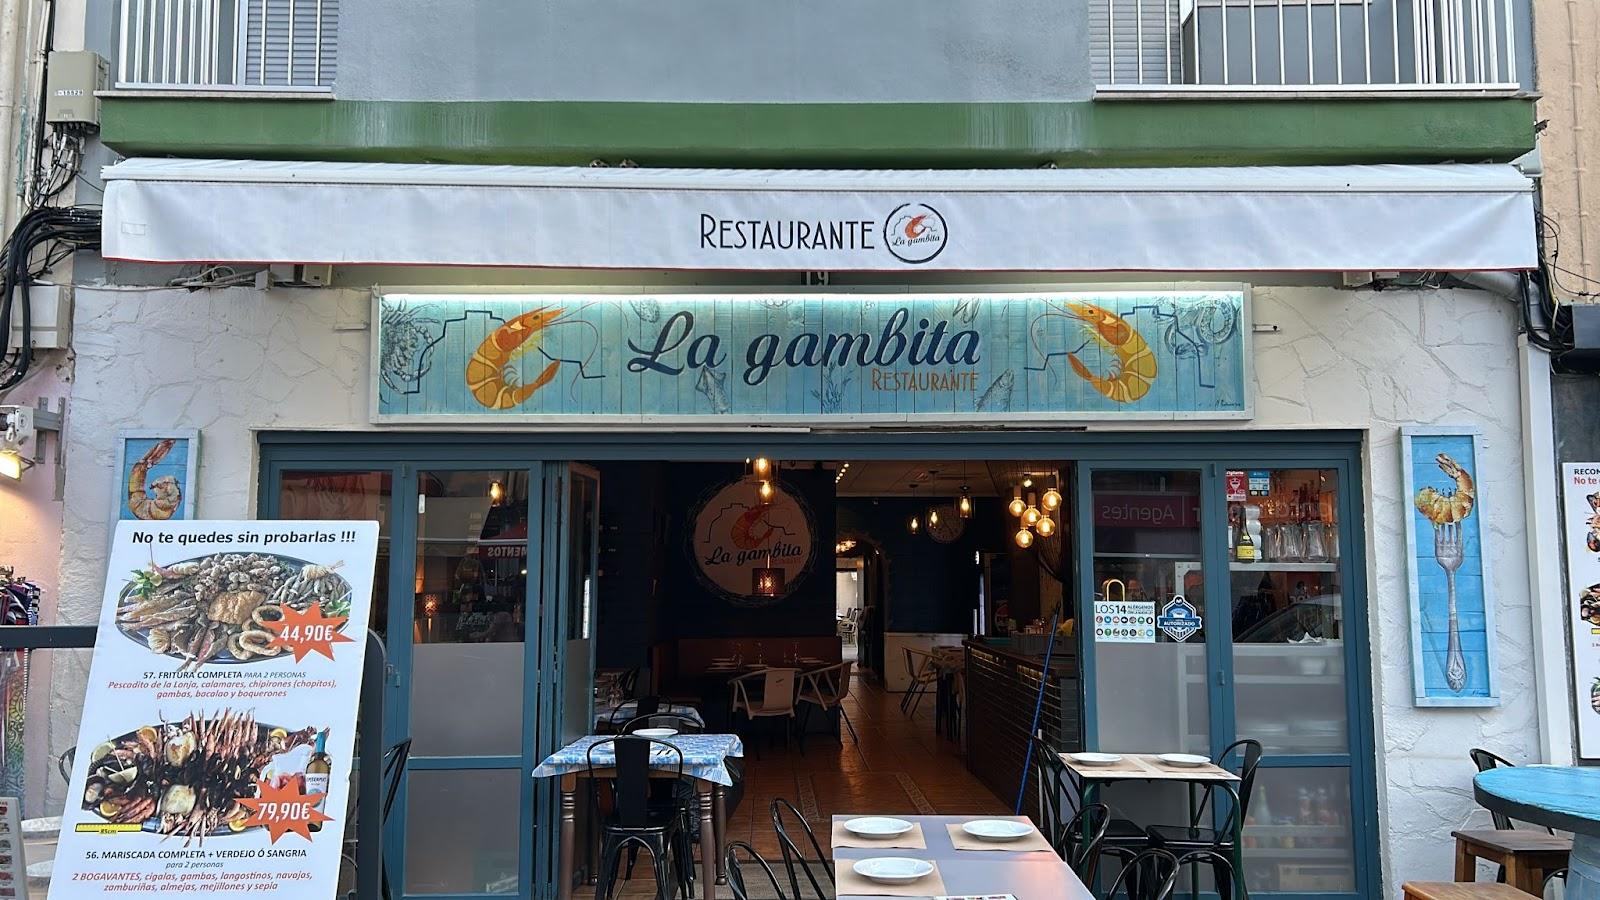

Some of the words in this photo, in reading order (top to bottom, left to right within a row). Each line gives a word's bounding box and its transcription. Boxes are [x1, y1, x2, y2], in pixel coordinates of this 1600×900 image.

[700, 213, 875, 250] RESTAURANTE
[892, 236, 905, 246] La
[907, 234, 940, 247] gambita
[626, 310, 727, 376] La
[743, 307, 981, 386] gambita
[871, 368, 980, 392] RESTAURANTE
[1574, 477, 1586, 485] No
[1588, 477, 1597, 485] te
[132, 531, 153, 544] No
[158, 532, 174, 543] te
[178, 531, 233, 546] quedes
[237, 531, 259, 543] sin
[264, 531, 336, 546] probarlas
[340, 531, 356, 543] !!!
[705, 546, 732, 566] La
[737, 541, 802, 567] gambita
[1095, 605, 1114, 614] LOS
[1115, 605, 1127, 614] 14
[280, 624, 334, 644] 44,90€
[143, 671, 156, 679] 57.
[158, 671, 195, 679] FRITURA
[197, 671, 243, 679] COMPLETA
[108, 681, 149, 689] Pescadito
[173, 681, 199, 690] Lonja,
[201, 680, 246, 689] calamares,
[248, 680, 291, 689] chipirones
[156, 690, 193, 700] gambas,
[195, 690, 229, 698] bacalao
[230, 691, 236, 699] y
[237, 690, 287, 699] boquerones
[257, 802, 311, 823] 79,90€
[85, 851, 99, 859] 56.
[101, 851, 156, 859] MARISCADA
[158, 850, 206, 859] COMPLETA
[216, 850, 255, 858] VERDEJO
[257, 848, 265, 858] Ó
[266, 849, 307, 858] SANGRIA
[190, 861, 224, 869] personas
[80, 872, 142, 881] BOGAVANTES,
[144, 872, 178, 882] cigalas,
[180, 872, 218, 882] gambas,
[220, 871, 273, 881] langostinos,
[276, 870, 313, 881] navajas,
[104, 883, 157, 892] zamburiñas,
[160, 882, 198, 892] almejas,
[200, 882, 245, 892] mejillones
[254, 882, 278, 892] sepia
